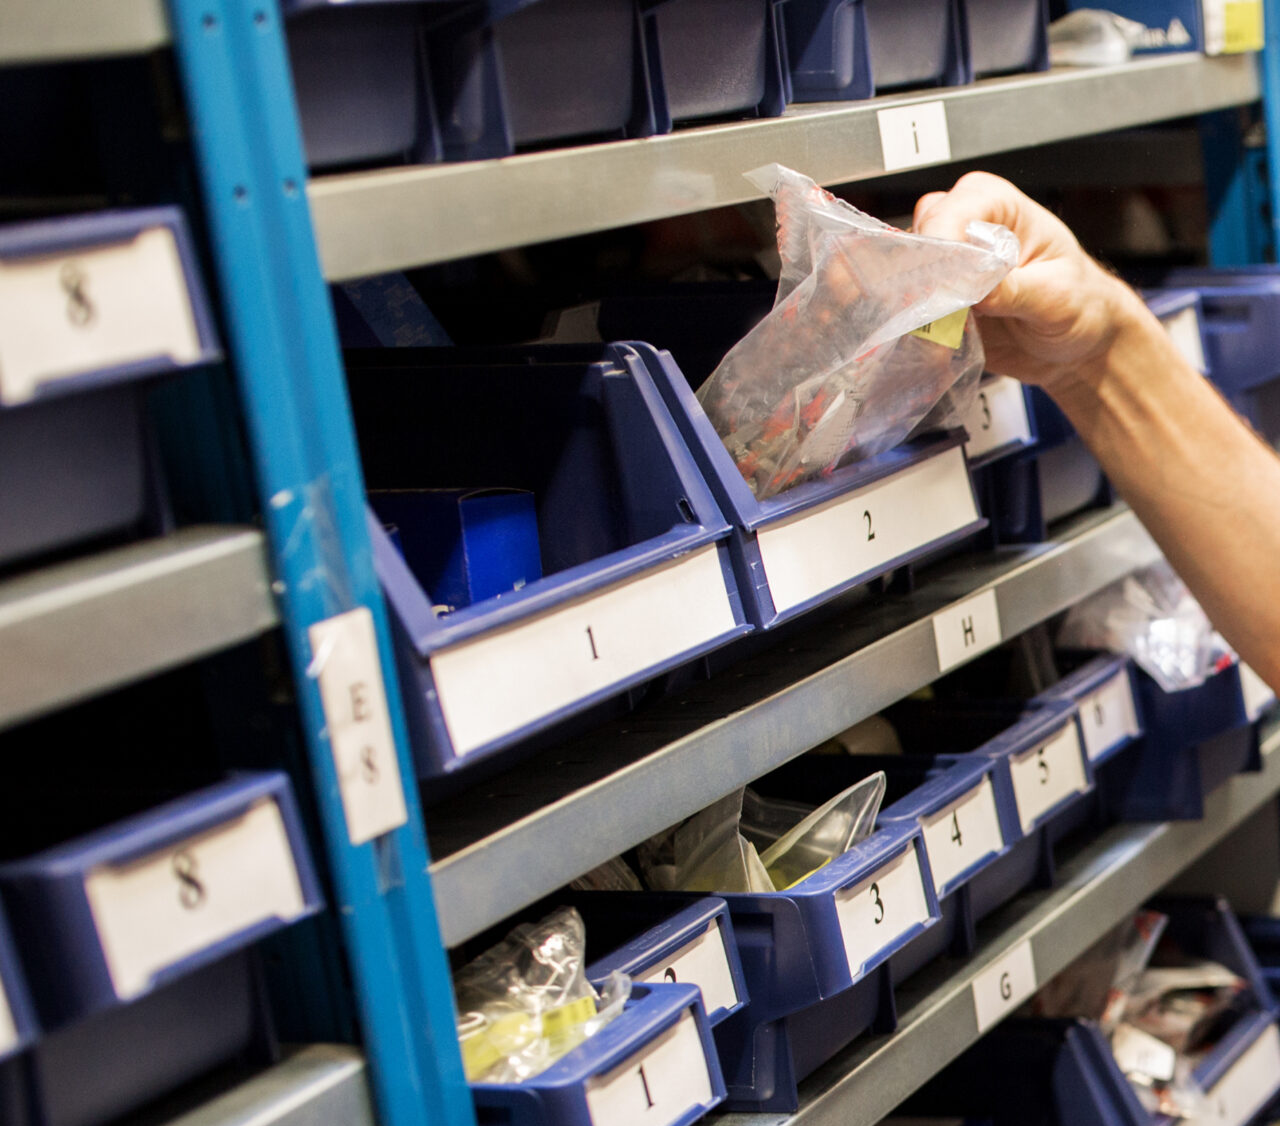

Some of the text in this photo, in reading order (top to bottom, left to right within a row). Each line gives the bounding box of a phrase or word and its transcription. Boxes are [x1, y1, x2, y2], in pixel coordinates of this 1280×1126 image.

[60, 258, 98, 330] 8
[978, 391, 992, 431] 3
[863, 510, 875, 542] 2
[587, 625, 599, 659] 1
[962, 615, 976, 648] H
[348, 680, 374, 722] E
[1037, 747, 1049, 785] 5
[951, 809, 963, 847] 4
[172, 848, 206, 911] 8
[869, 882, 884, 925] 3
[1000, 972, 1012, 1001] G
[637, 1063, 655, 1109] 1
